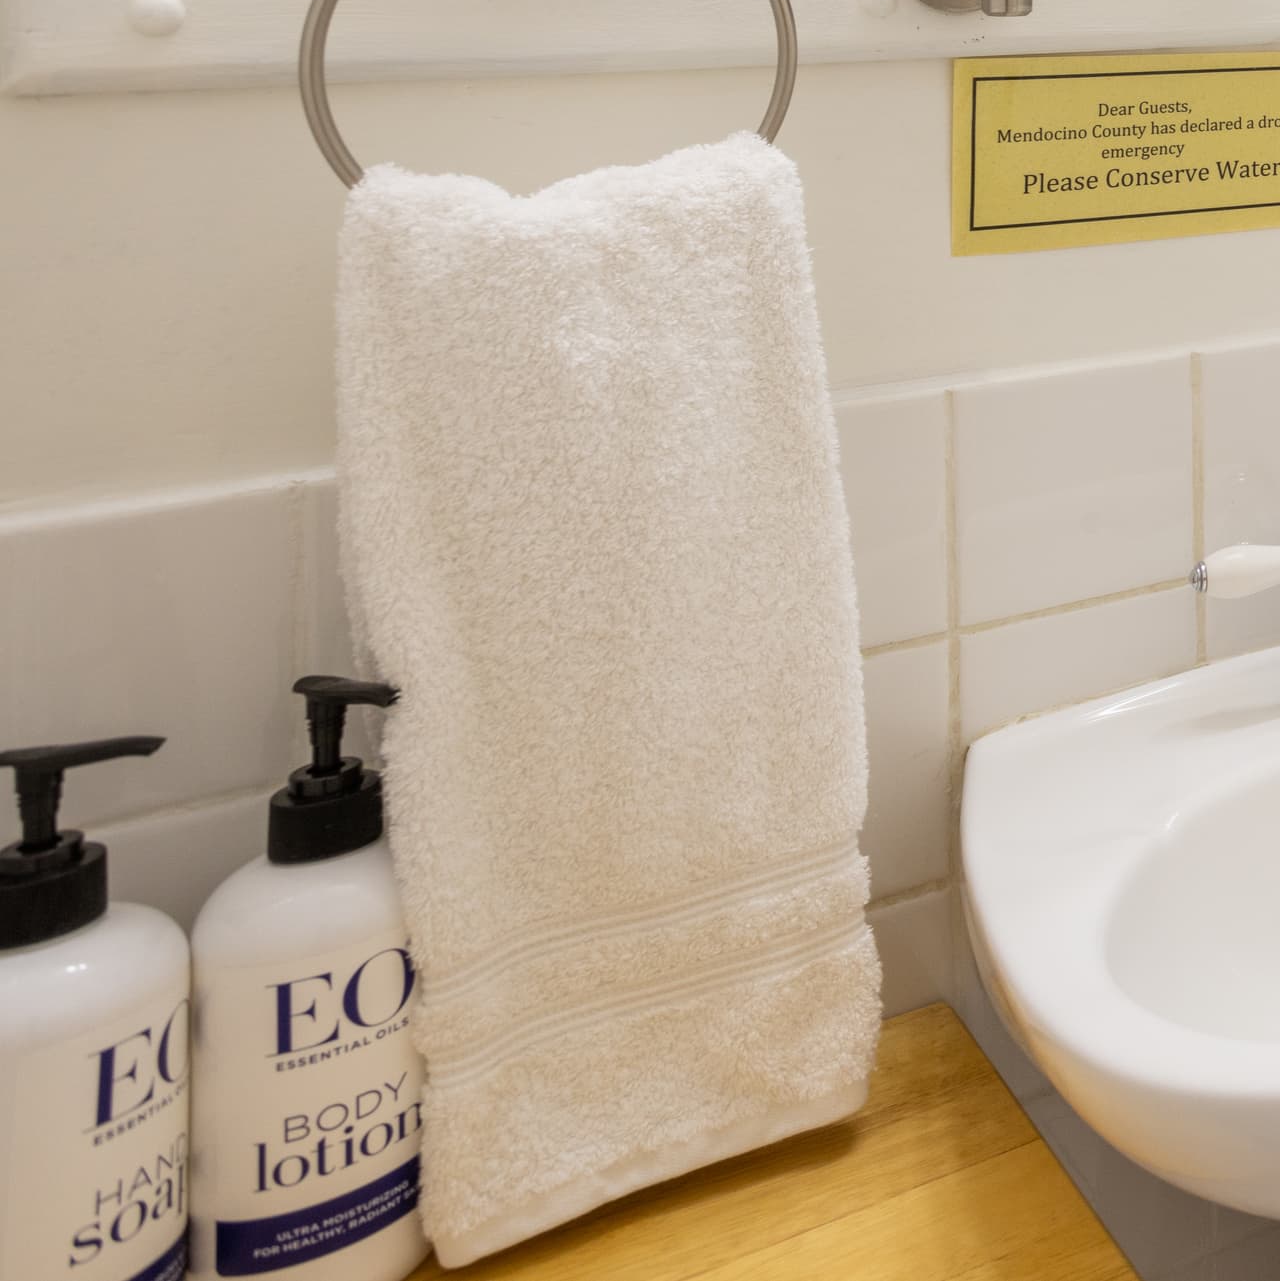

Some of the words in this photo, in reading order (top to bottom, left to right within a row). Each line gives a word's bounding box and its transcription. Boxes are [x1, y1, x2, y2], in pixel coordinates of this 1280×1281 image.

[997, 127, 1088, 143] Mendocino
[1092, 124, 1147, 139] County
[1151, 121, 1176, 135] has
[1180, 117, 1242, 133] declared
[1246, 119, 1255, 129] a
[1098, 103, 1135, 117] Dear
[1139, 101, 1192, 115] Guests,
[1023, 173, 1099, 195] Please
[1106, 168, 1210, 189] Conserve
[1101, 144, 1185, 160] emergency
[264, 947, 417, 1059] EO
[275, 1036, 372, 1072] ESSENTIAL
[375, 1016, 410, 1040] OILS
[93, 1093, 174, 1148] ESSENTIAL
[284, 1071, 408, 1144] BODY
[94, 1131, 187, 1217] HAND
[253, 1102, 423, 1194] lotion
[252, 1244, 281, 1259] FOR
[348, 1194, 401, 1230] RADIANT
[276, 1223, 321, 1242] ULTRA
[322, 1180, 409, 1229] MOISTURIZING
